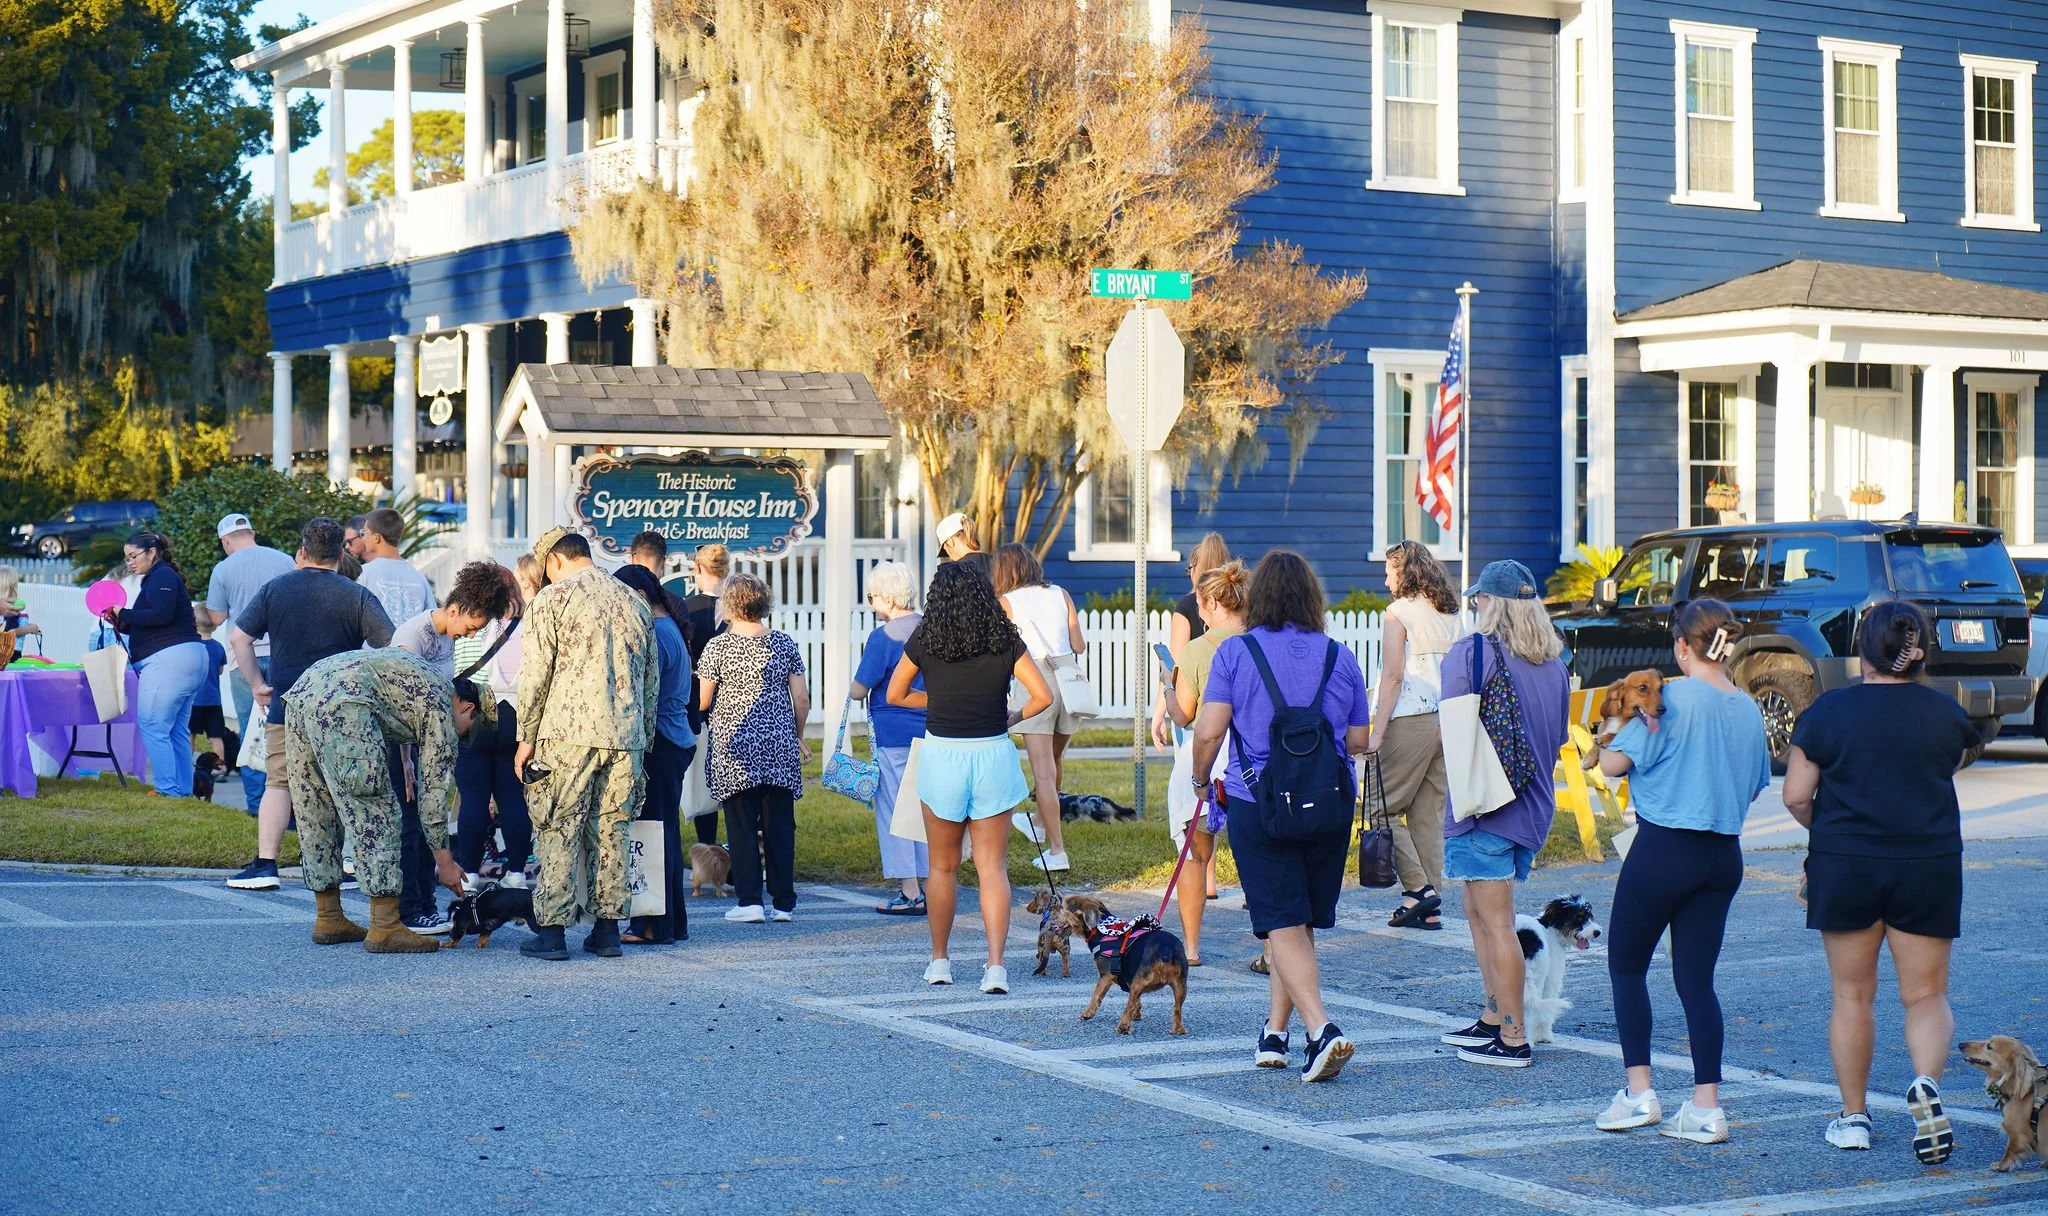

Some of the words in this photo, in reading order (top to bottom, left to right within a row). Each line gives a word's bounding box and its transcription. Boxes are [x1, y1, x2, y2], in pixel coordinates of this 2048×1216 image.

[1093, 273, 1101, 293] E
[1108, 273, 1157, 295] BRYANT
[1180, 274, 1190, 284] ST
[2010, 350, 2025, 363] 101
[656, 472, 681, 490] The
[681, 473, 736, 490] Historic
[592, 490, 684, 527] Spencer
[683, 491, 756, 518] House
[757, 491, 797, 518] Inn
[670, 523, 686, 539] &
[686, 521, 750, 544] Breakfast
